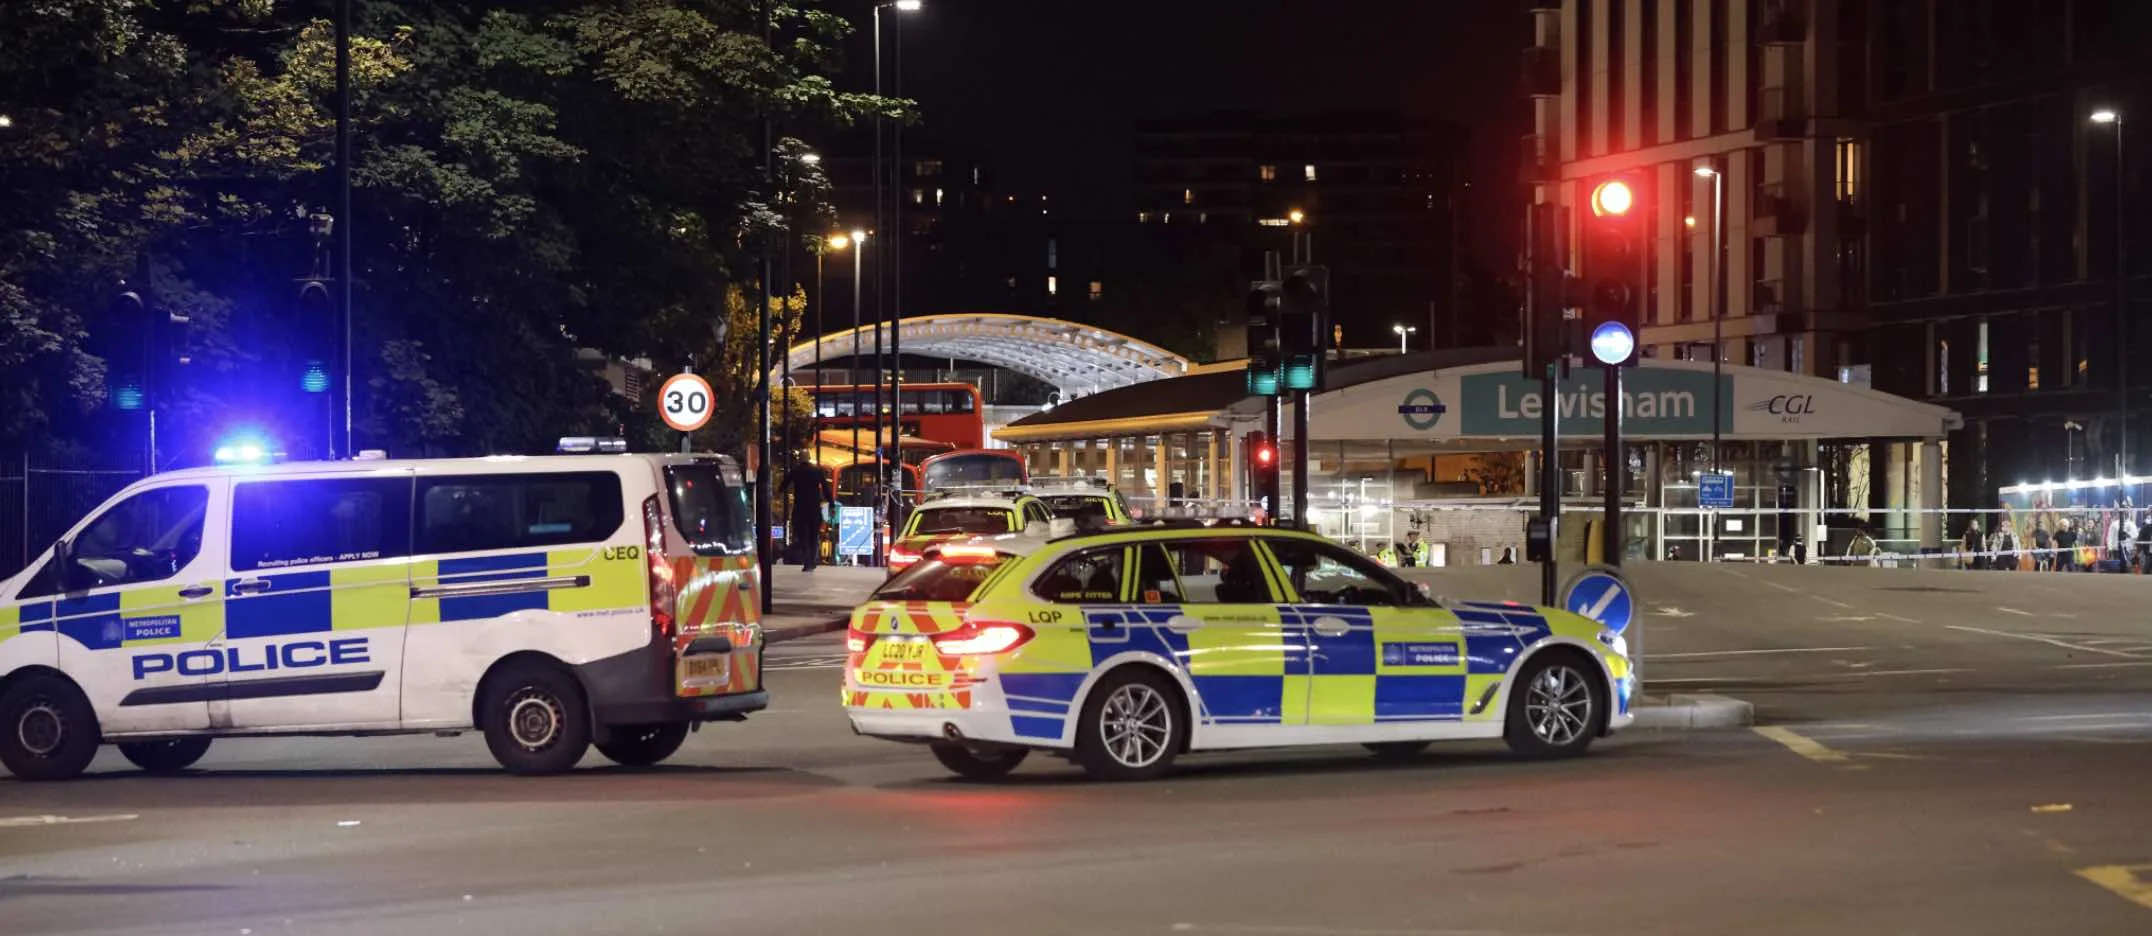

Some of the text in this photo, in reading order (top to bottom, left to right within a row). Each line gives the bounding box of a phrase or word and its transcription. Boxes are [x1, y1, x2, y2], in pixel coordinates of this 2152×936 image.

[667, 390, 706, 414] 30
[1768, 395, 1815, 415] CGL
[604, 545, 640, 561] CEQ
[129, 618, 177, 628] METROPOLITAN
[1028, 610, 1063, 623] LQP
[136, 627, 171, 637] POLICE
[132, 637, 371, 680] POLICE
[1416, 653, 1450, 663] POLICE
[862, 671, 943, 686] POLICE
